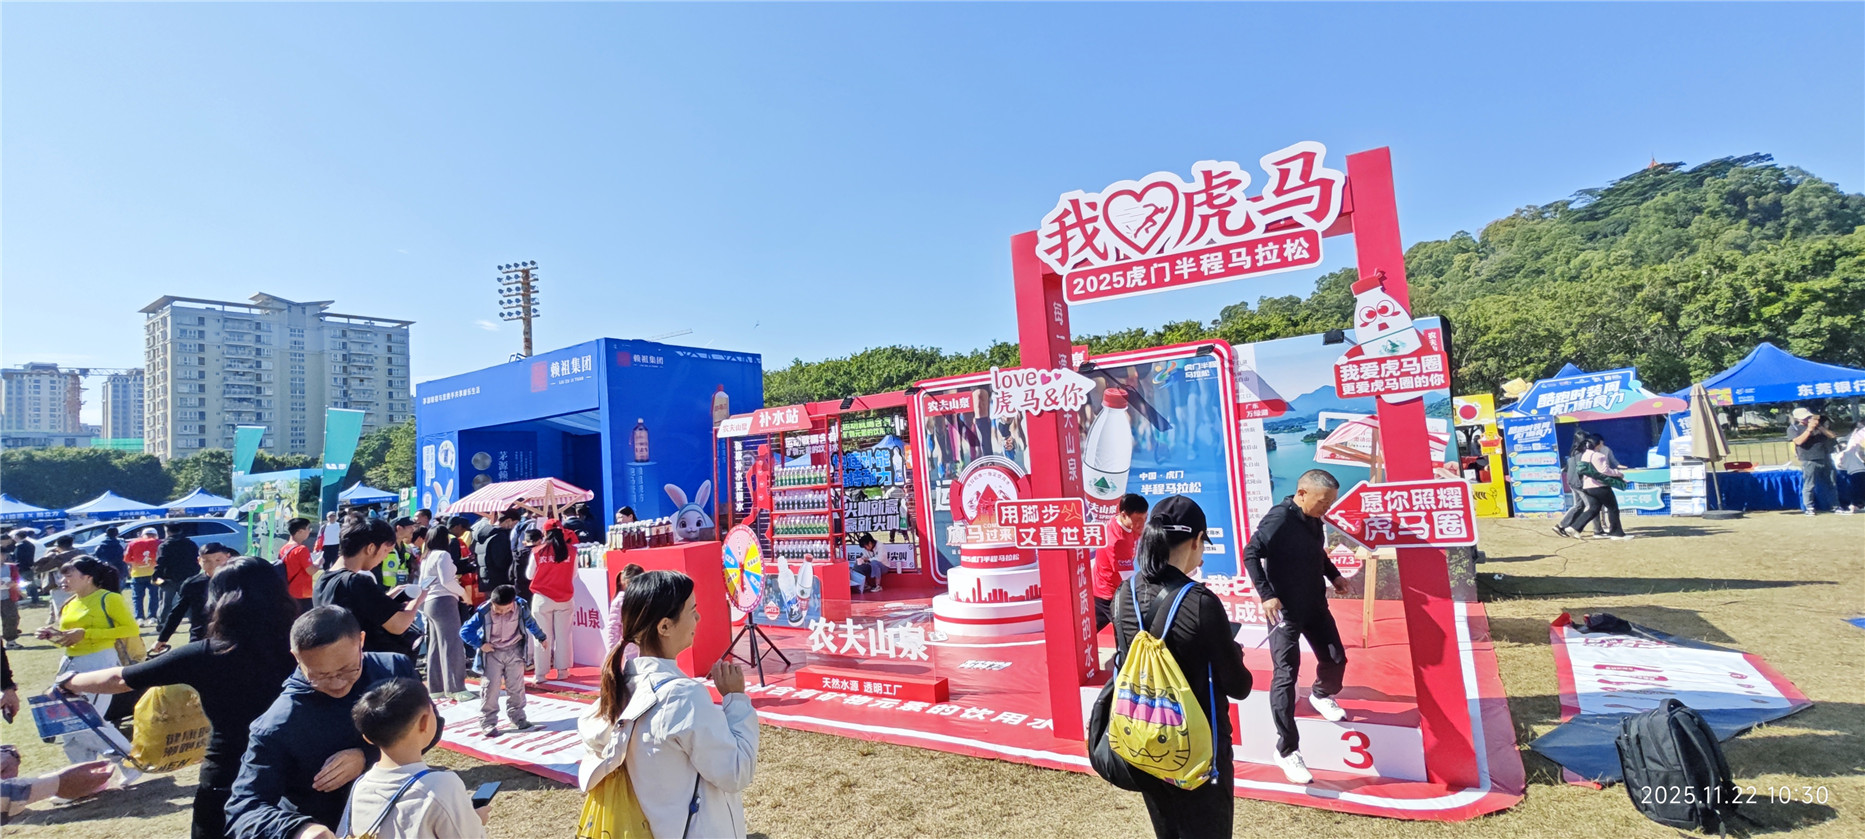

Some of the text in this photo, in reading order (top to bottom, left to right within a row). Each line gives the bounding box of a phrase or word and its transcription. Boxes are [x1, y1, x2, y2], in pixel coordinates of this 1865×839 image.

[1043, 151, 1336, 267] 我 虎马
[1072, 237, 1311, 296] 2025虎门半程马拉松
[1339, 354, 1443, 382] 我爱虎马圈
[994, 370, 1037, 390] love
[1341, 373, 1445, 395] 更爱虎马圈的你
[1797, 381, 1865, 397] 东莞银行
[927, 397, 971, 413] 农夫山泉
[994, 382, 1085, 415] 虎马&你
[759, 407, 799, 428] 补水站
[1140, 481, 1202, 495] 半程马拉松
[844, 499, 899, 517] 尖叫就赢
[1360, 487, 1464, 513] 愿你照耀
[1000, 504, 1061, 524] 用脚步
[1018, 526, 1103, 546] 丈量世界
[1363, 510, 1467, 541] 虎马圈
[574, 606, 601, 629] 山泉
[808, 617, 930, 662] 农夫山泉
[822, 677, 902, 696] 天然水源 透明工厂
[1342, 732, 1374, 769] 3
